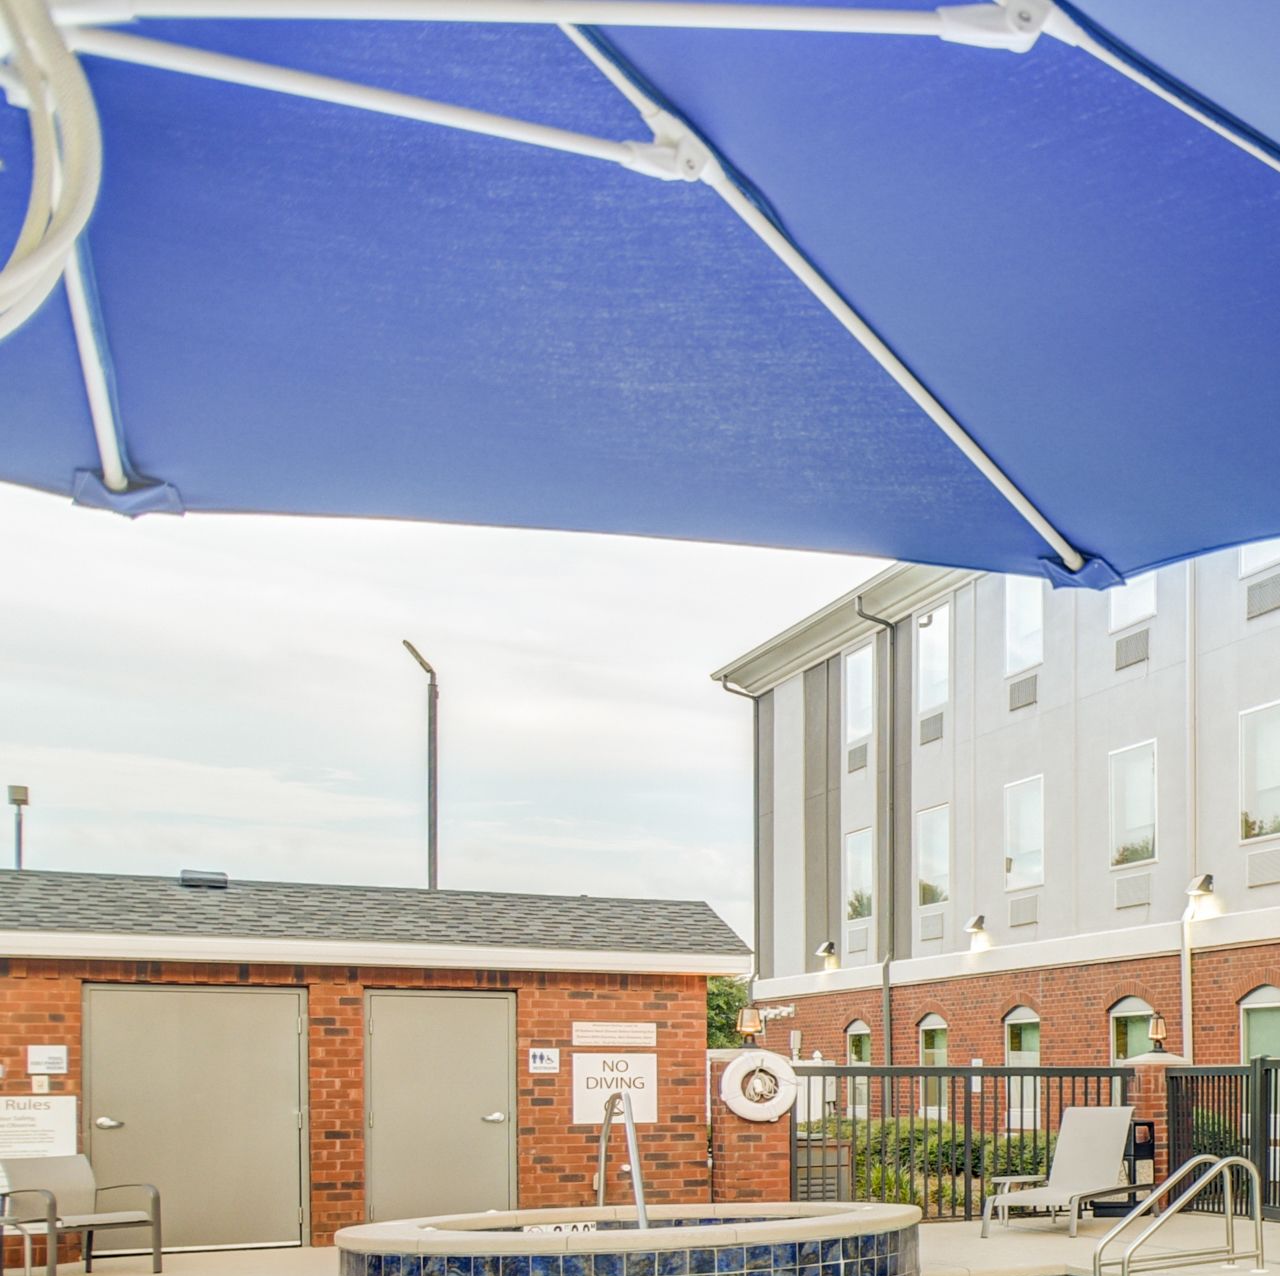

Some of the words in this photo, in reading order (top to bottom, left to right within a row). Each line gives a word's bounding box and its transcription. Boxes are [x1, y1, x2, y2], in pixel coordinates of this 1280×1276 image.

[602, 1059, 629, 1073] NO
[585, 1076, 645, 1090] DIVING
[5, 1099, 51, 1111] Rules
